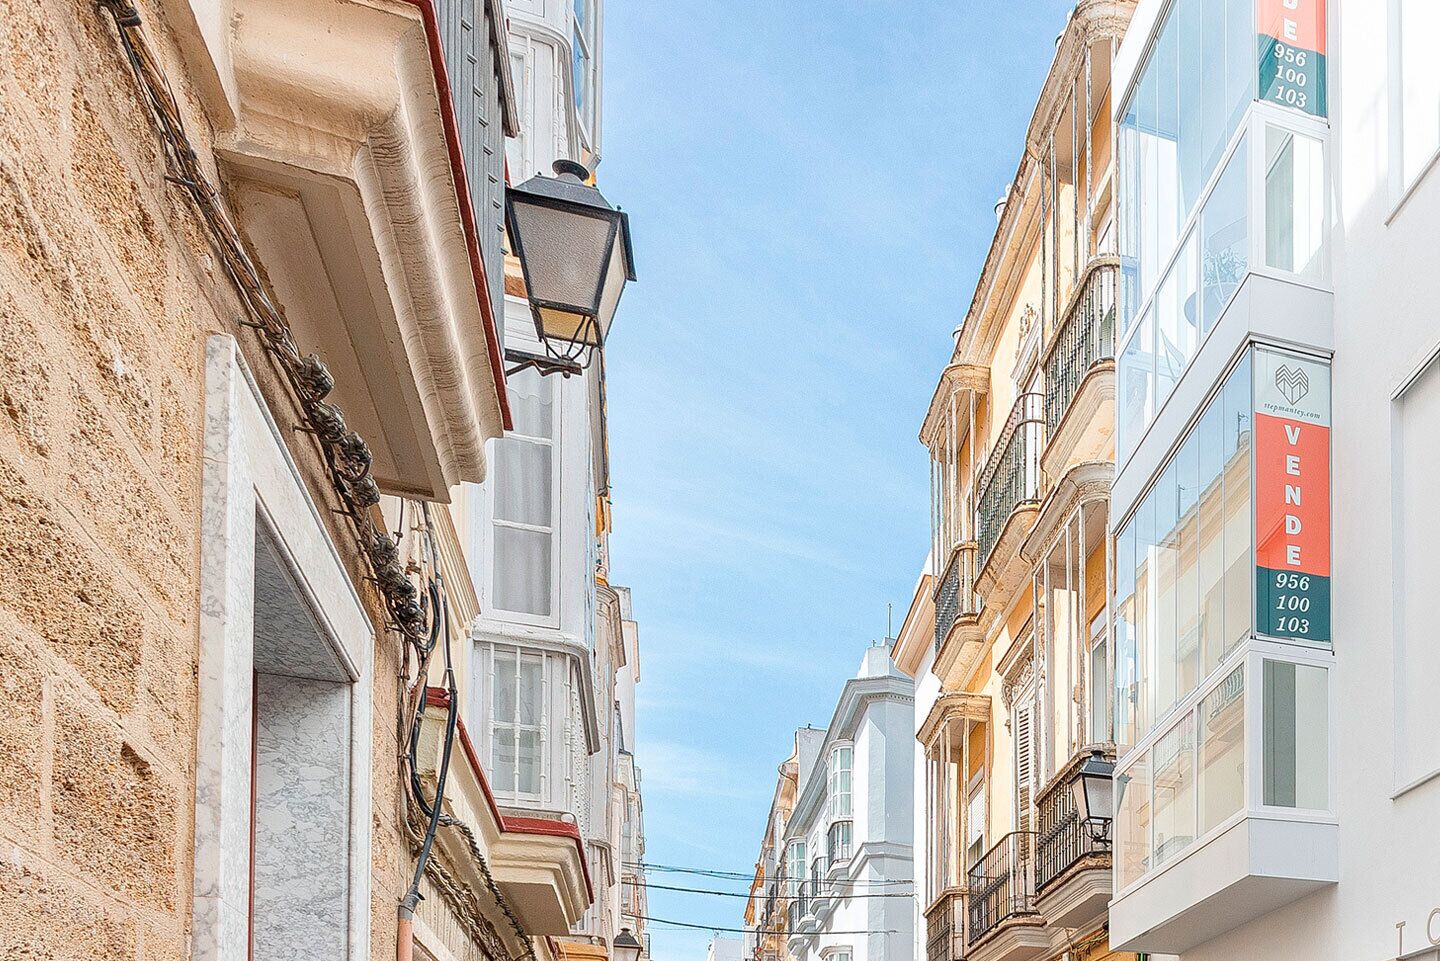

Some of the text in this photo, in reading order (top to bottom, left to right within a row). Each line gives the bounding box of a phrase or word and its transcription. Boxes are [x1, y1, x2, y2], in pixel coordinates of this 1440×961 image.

[1274, 43, 1307, 66] 956
[1275, 65, 1307, 87] 100
[1275, 86, 1307, 108] 103
[1284, 424, 1302, 566] VENDE
[1275, 572, 1310, 591] 956
[1275, 595, 1310, 613] 100
[1275, 616, 1310, 634] 103
